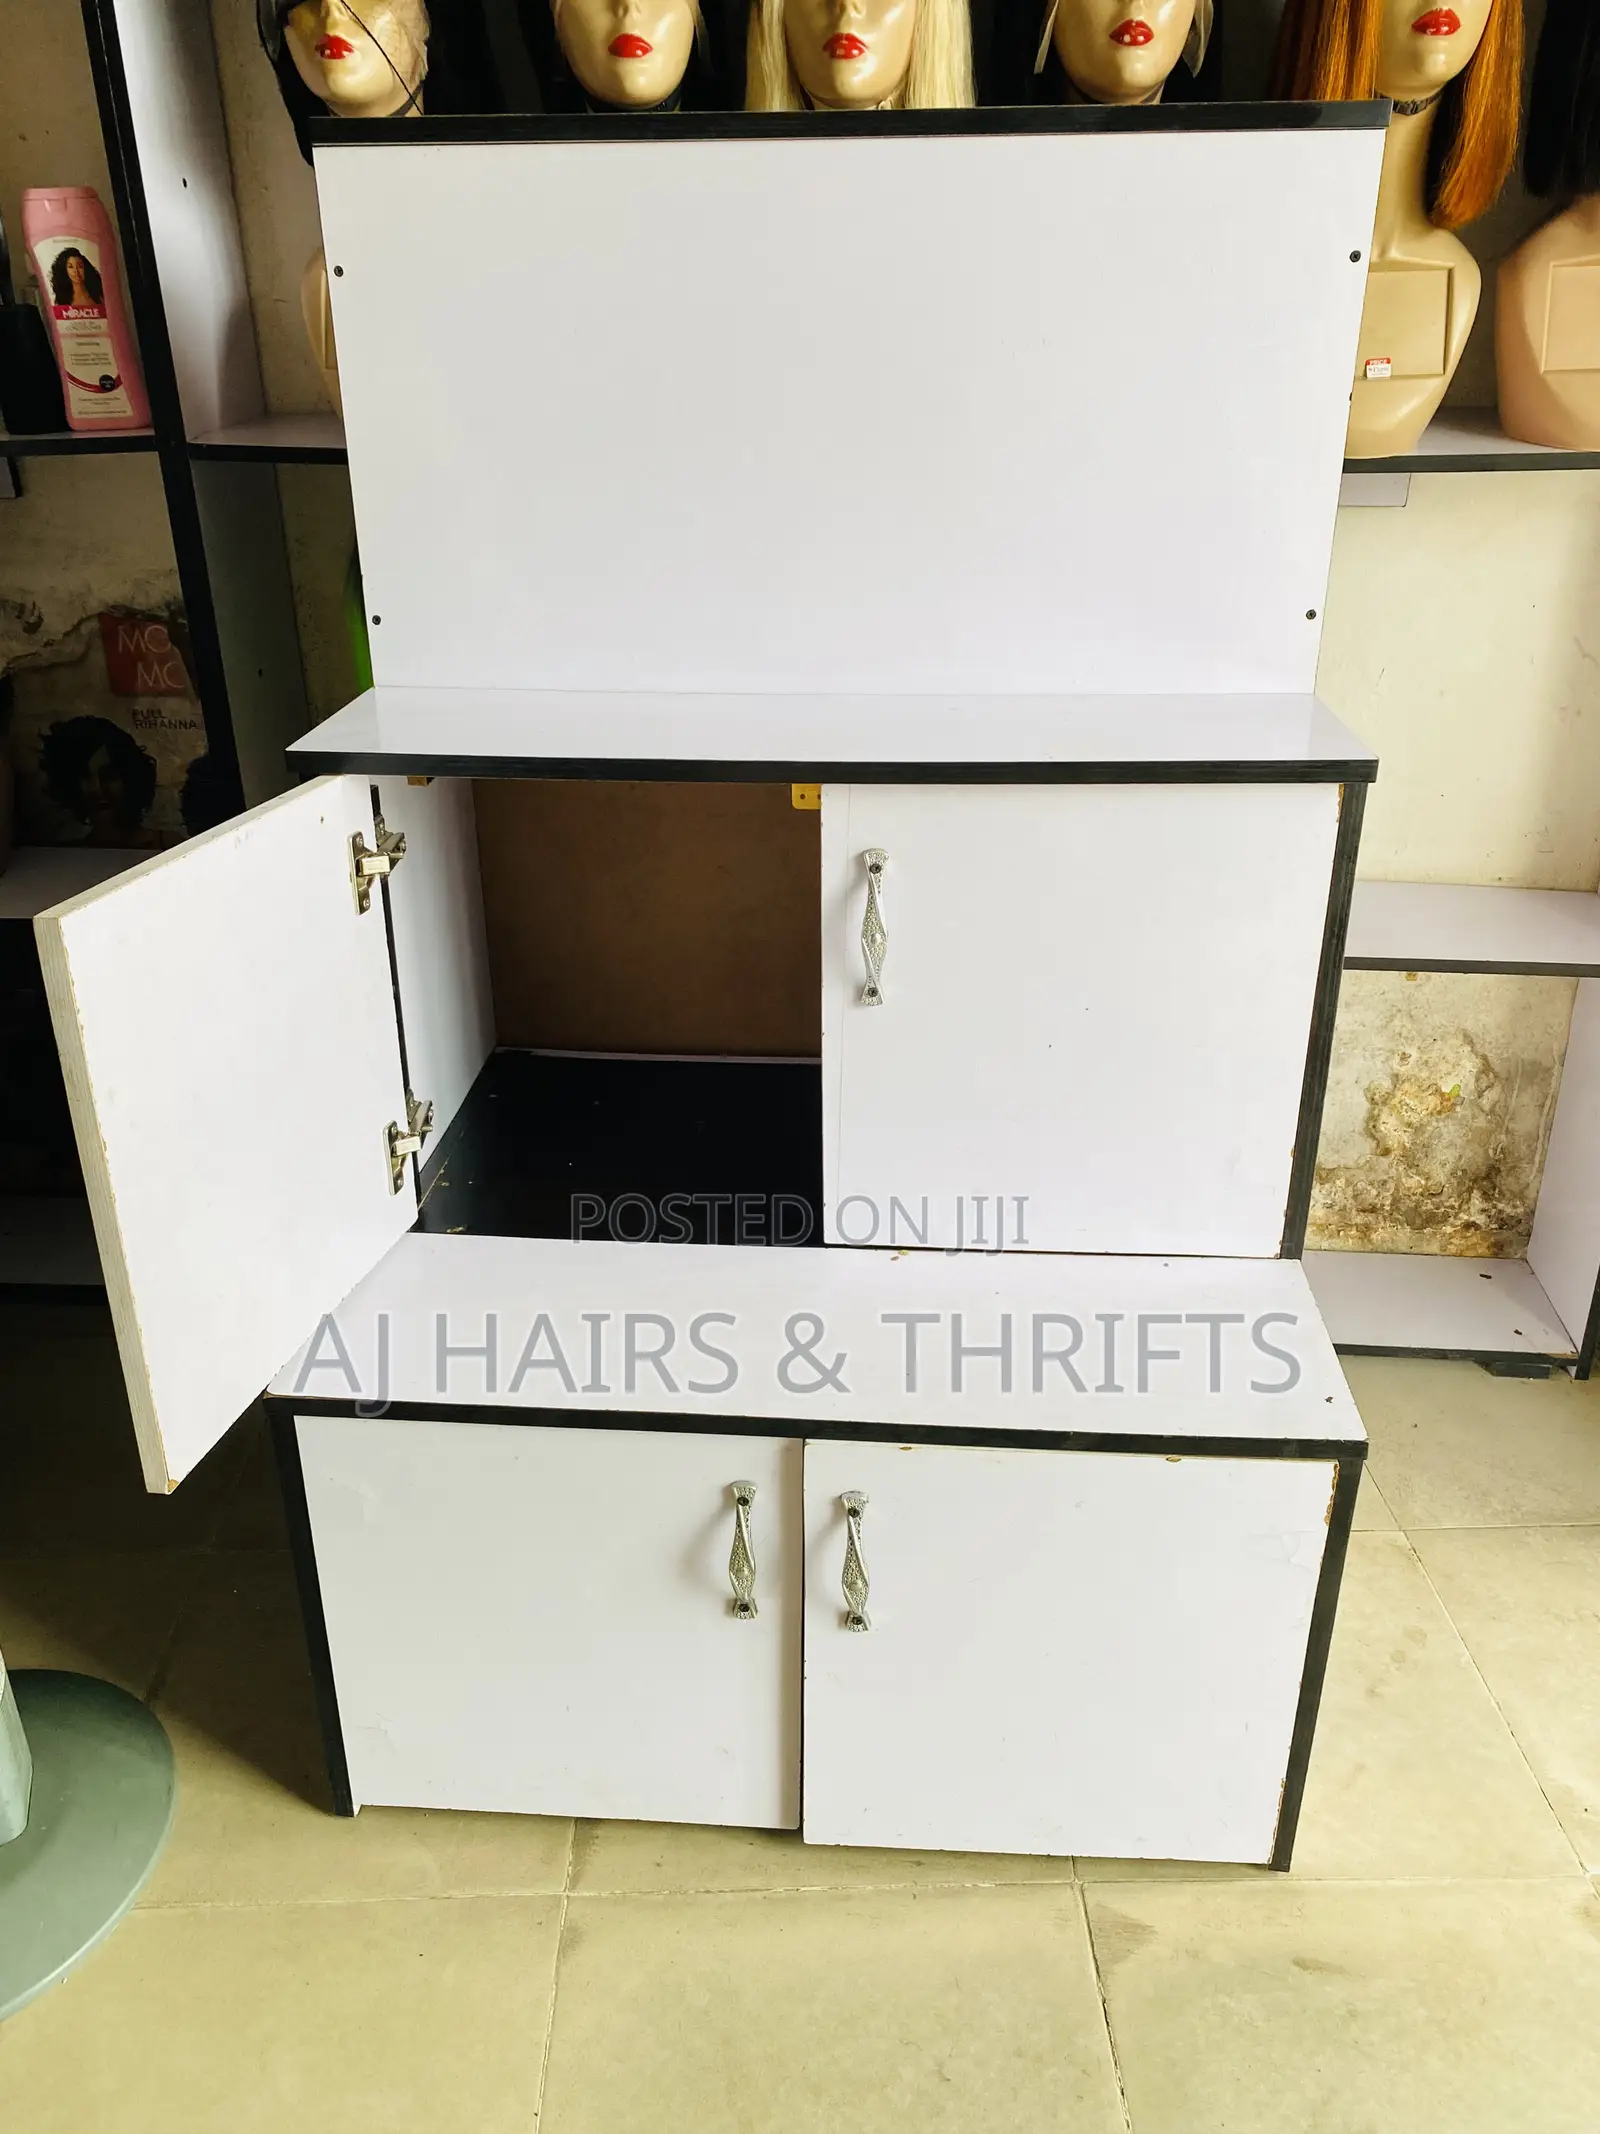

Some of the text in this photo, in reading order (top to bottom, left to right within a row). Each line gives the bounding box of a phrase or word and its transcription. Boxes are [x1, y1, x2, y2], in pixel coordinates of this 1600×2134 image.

[62, 306, 100, 319] MIRACLE
[132, 708, 167, 720] FULL
[135, 719, 199, 731] RIHANNA
